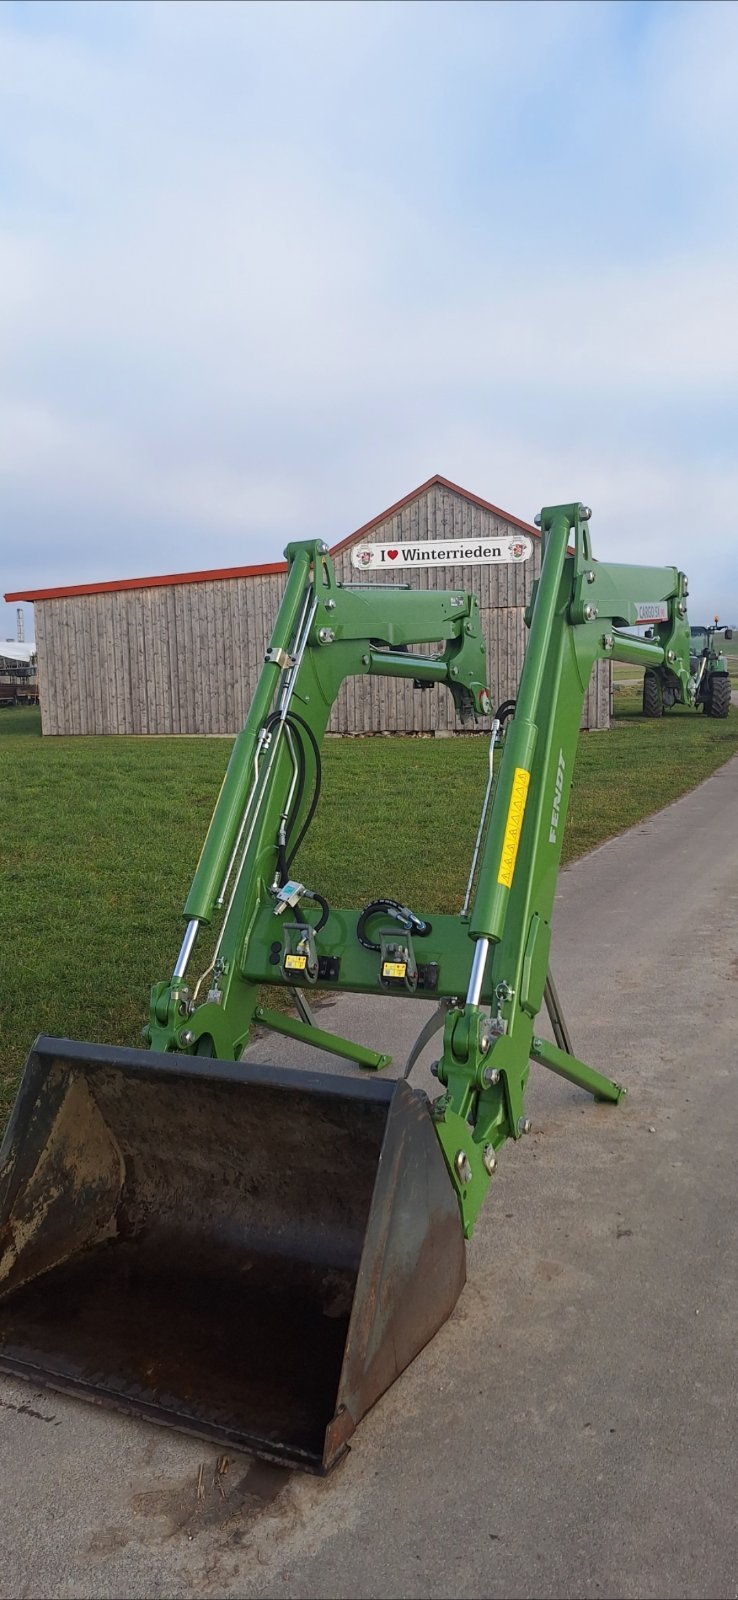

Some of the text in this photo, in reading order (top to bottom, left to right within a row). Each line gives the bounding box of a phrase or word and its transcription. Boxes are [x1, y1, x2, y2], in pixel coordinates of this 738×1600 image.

[380, 545, 501, 562] I Winterrieden
[549, 747, 565, 843] FENDT
